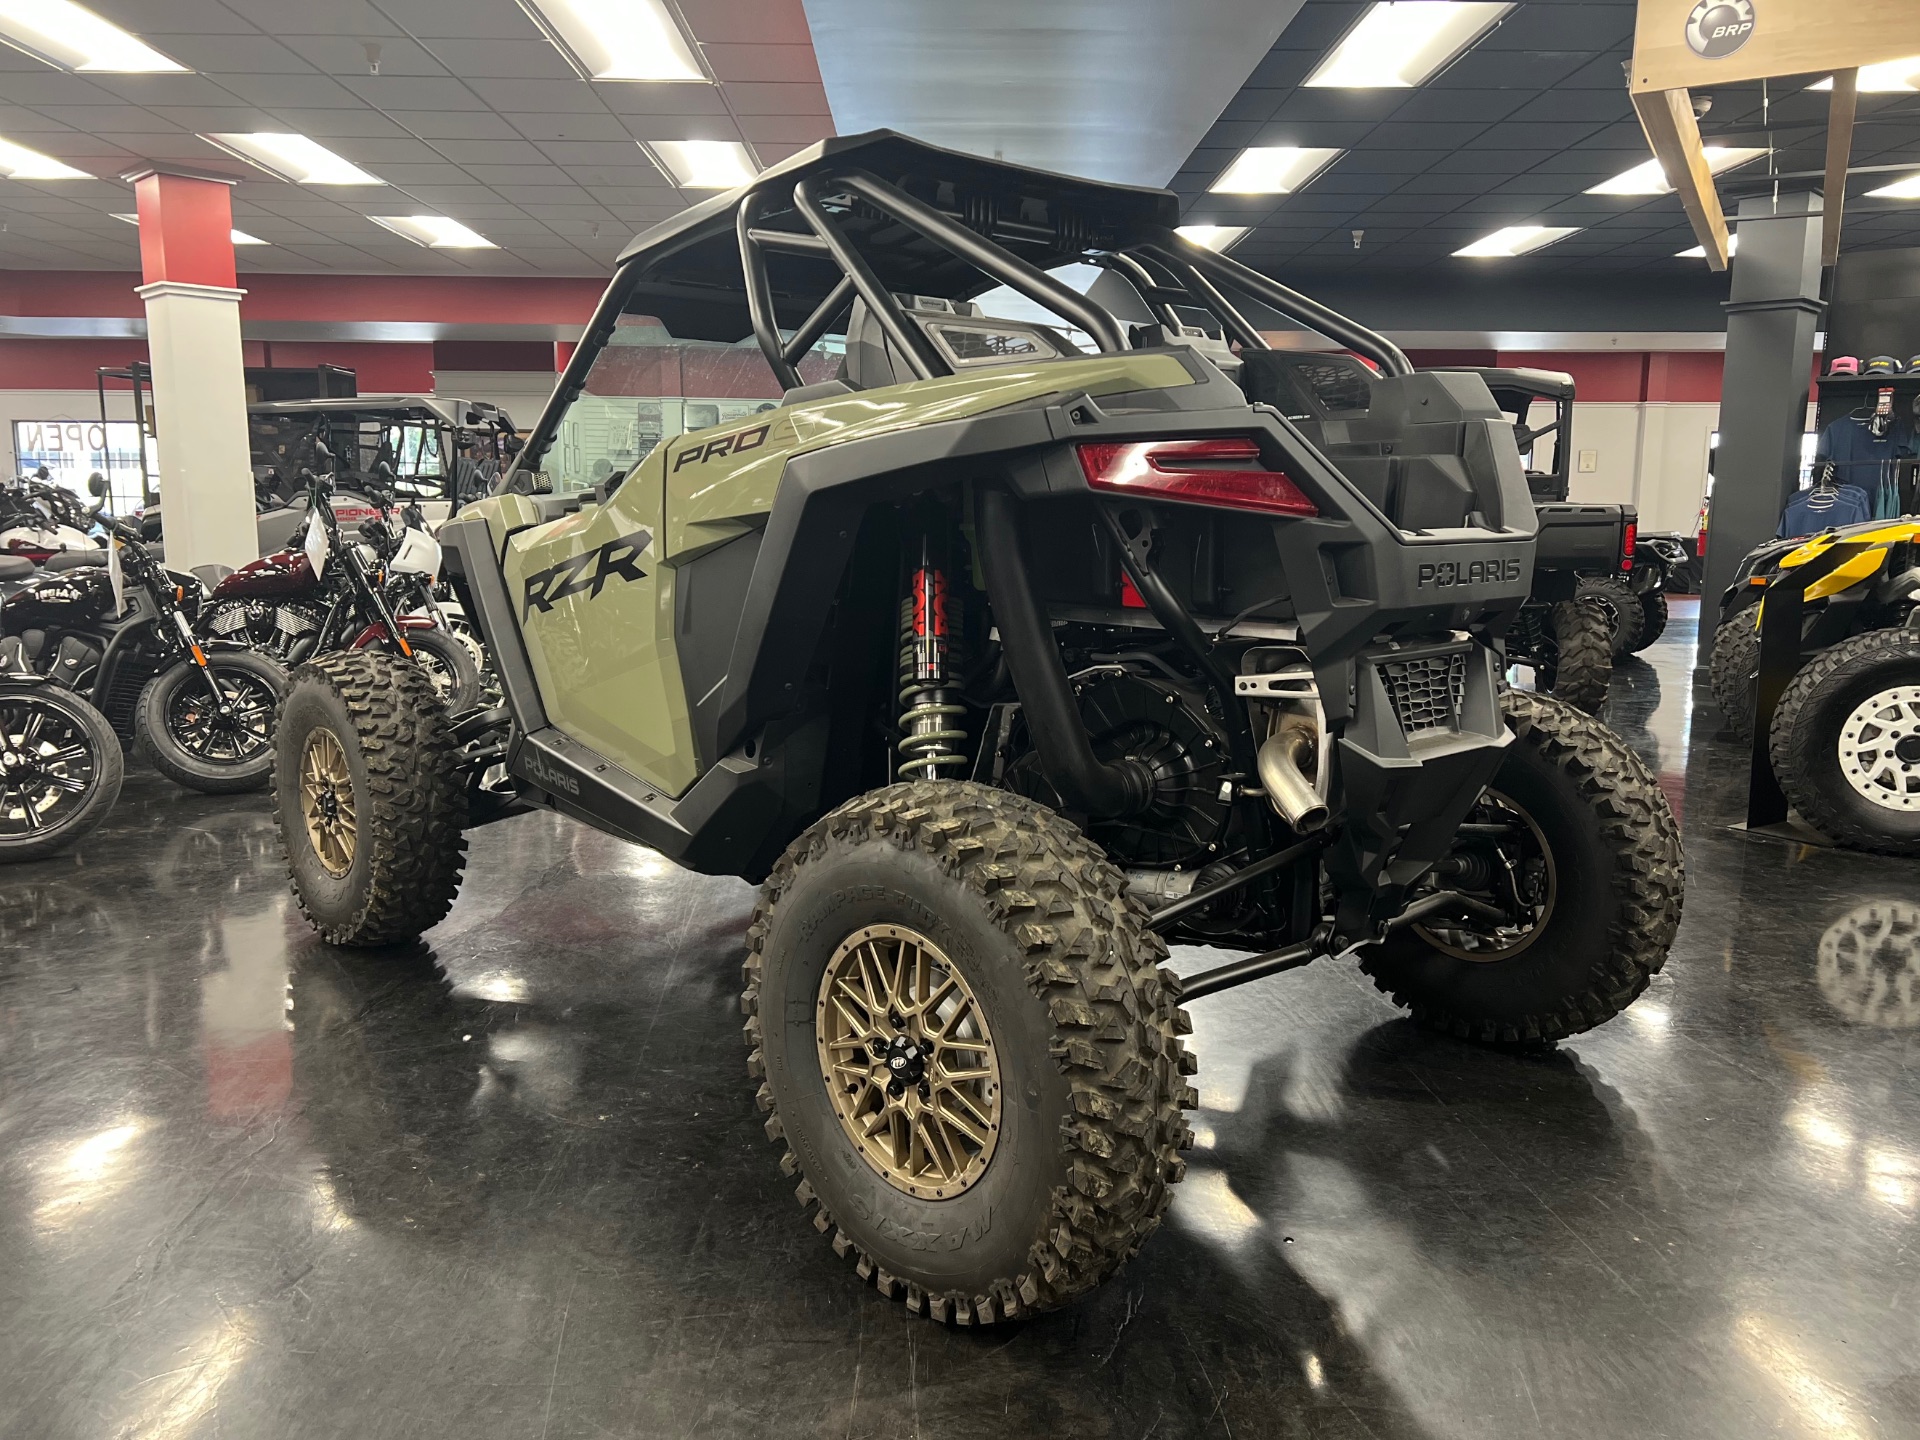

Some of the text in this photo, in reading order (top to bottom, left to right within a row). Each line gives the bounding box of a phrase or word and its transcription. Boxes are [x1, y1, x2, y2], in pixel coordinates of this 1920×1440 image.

[1712, 22, 1752, 38] BRP
[673, 424, 771, 473] PRO
[523, 529, 653, 627] RZR
[1417, 558, 1521, 589] POLARIS
[524, 754, 579, 796] POLARIS
[799, 884, 886, 942] RAMPAGE
[851, 1193, 992, 1252] MAXXIS
